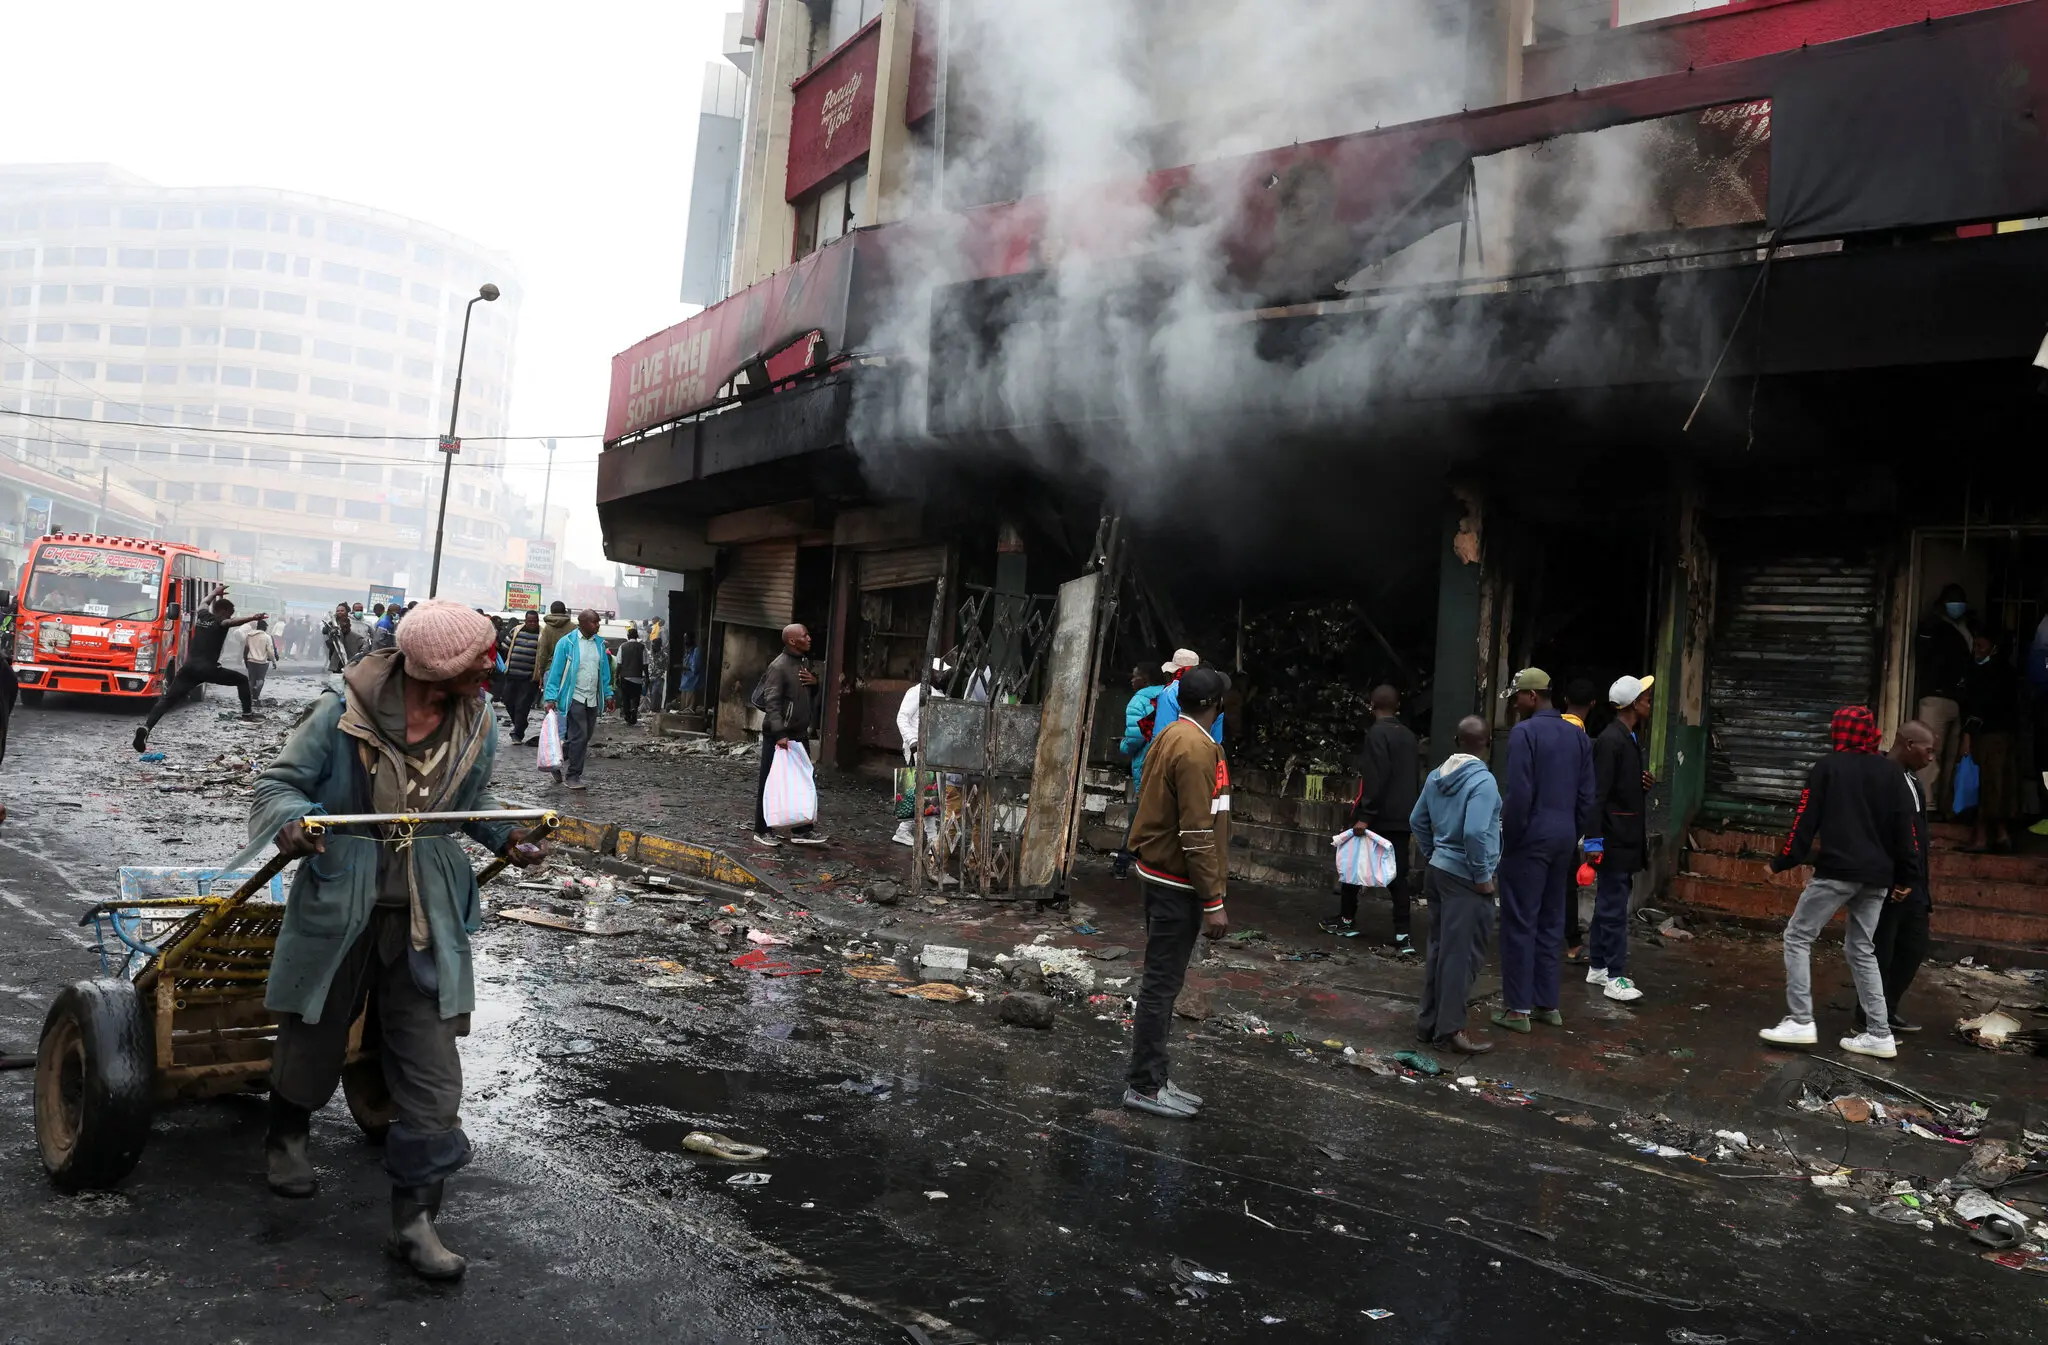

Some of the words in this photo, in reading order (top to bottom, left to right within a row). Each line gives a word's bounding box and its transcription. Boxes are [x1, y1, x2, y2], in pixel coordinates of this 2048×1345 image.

[821, 72, 862, 114] Beauty
[825, 105, 853, 149] you
[629, 350, 665, 395] LIVE
[626, 388, 663, 431] SOFT
[43, 547, 97, 563] CHRIST
[104, 554, 159, 570] REDEEMER
[1796, 788, 1811, 813] BLACK
